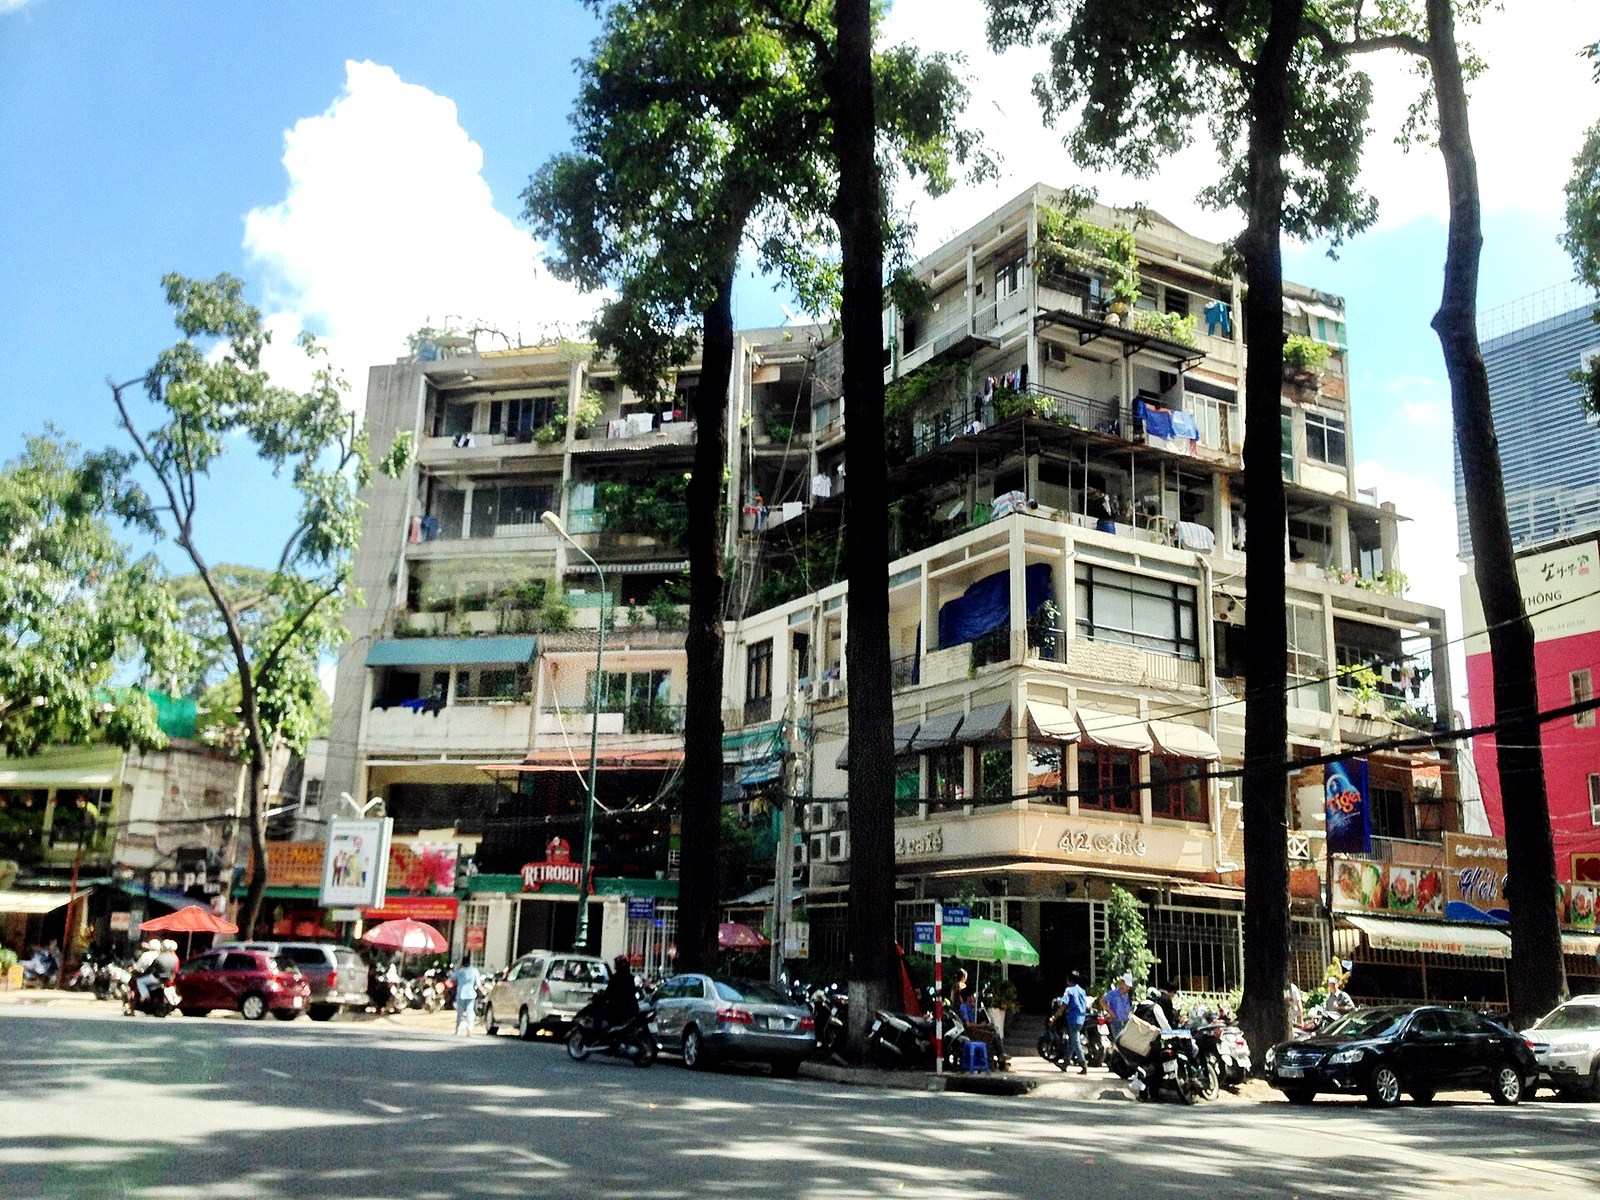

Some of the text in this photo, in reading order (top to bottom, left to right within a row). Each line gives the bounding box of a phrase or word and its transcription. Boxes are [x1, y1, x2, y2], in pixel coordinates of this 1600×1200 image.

[1327, 789, 1362, 813] Tiger
[906, 826, 944, 854] café
[1059, 828, 1148, 857] 42 café
[524, 865, 584, 887] RETROBIT
